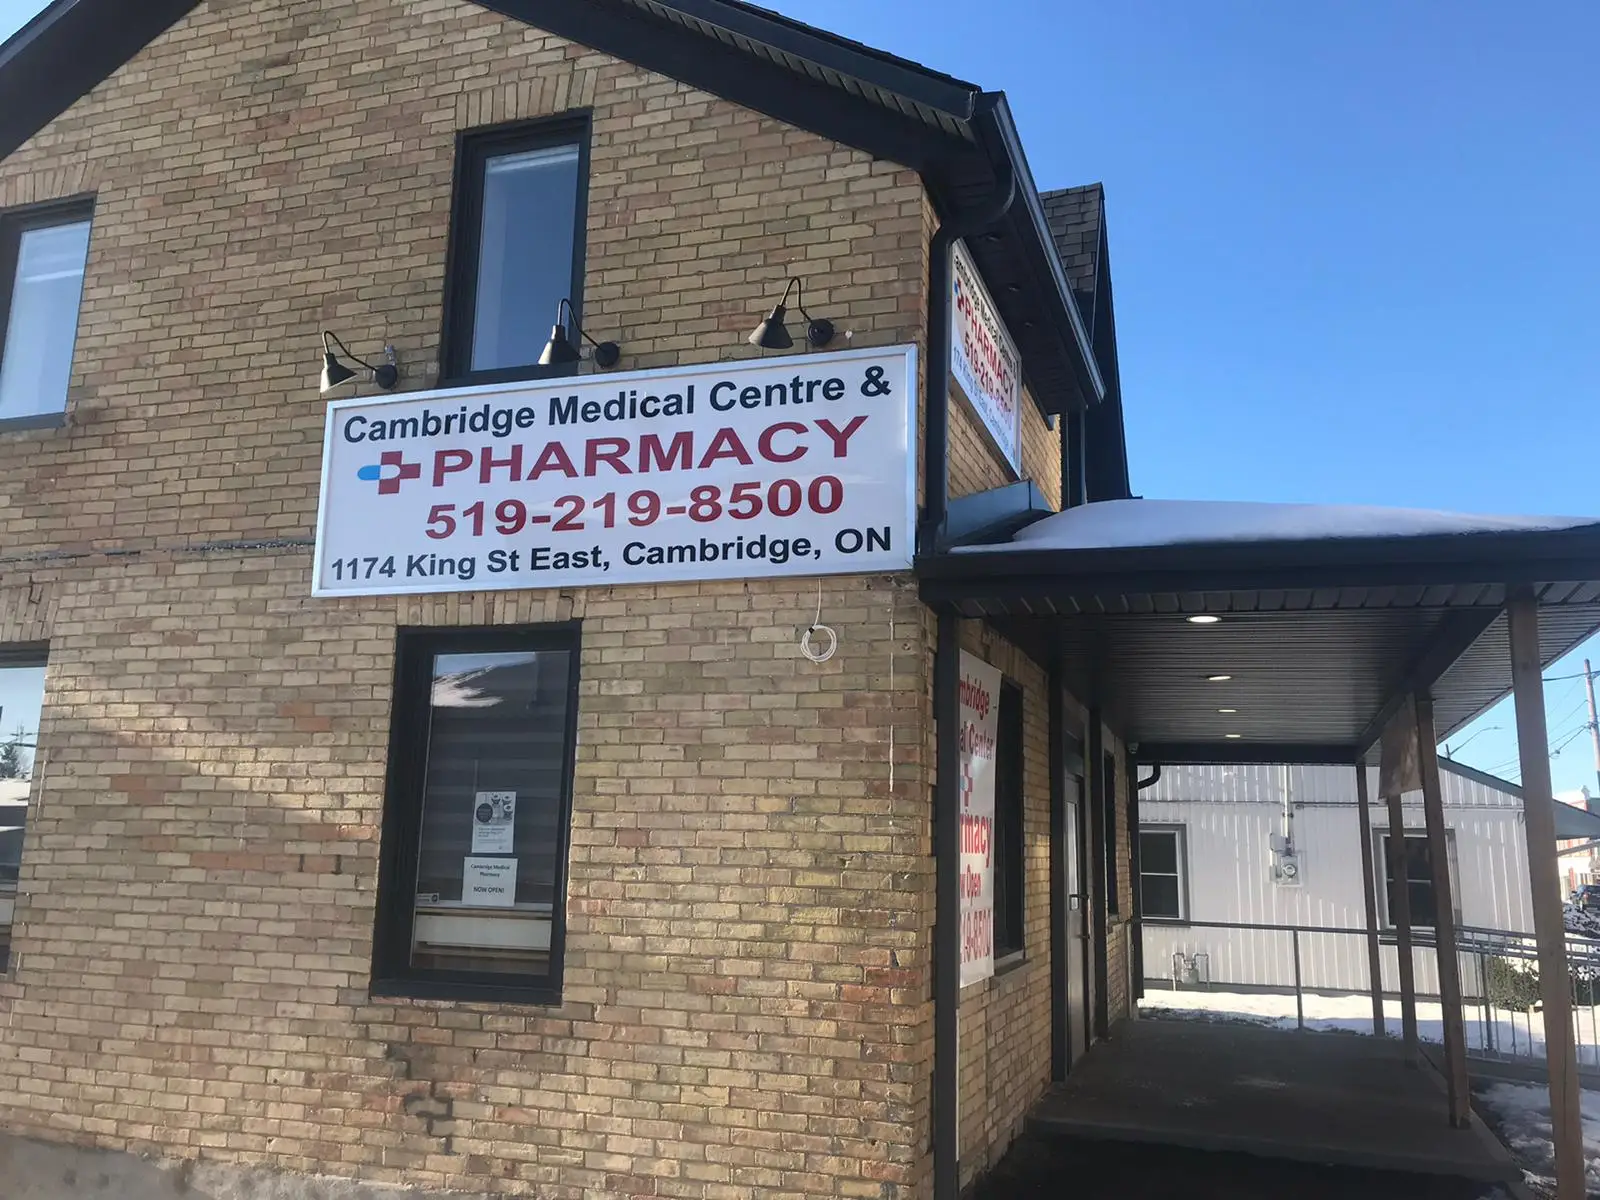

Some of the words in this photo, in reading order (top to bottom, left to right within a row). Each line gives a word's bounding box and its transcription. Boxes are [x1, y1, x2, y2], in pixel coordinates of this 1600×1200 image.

[964, 294, 1014, 402] PHARMACY
[343, 404, 535, 443] Cambridge
[548, 385, 695, 426] Medical
[710, 375, 845, 411] Centre
[860, 365, 892, 397] &
[432, 415, 869, 487] PHARMACY
[425, 475, 844, 540] 519-219-8500
[331, 556, 396, 581] 1174
[406, 553, 476, 580] King
[487, 548, 520, 573] St
[530, 547, 610, 571] East,
[622, 534, 821, 565] Cambridge,
[834, 526, 891, 553] ON
[960, 673, 990, 720] mbridge
[960, 813, 992, 868] rmacy
